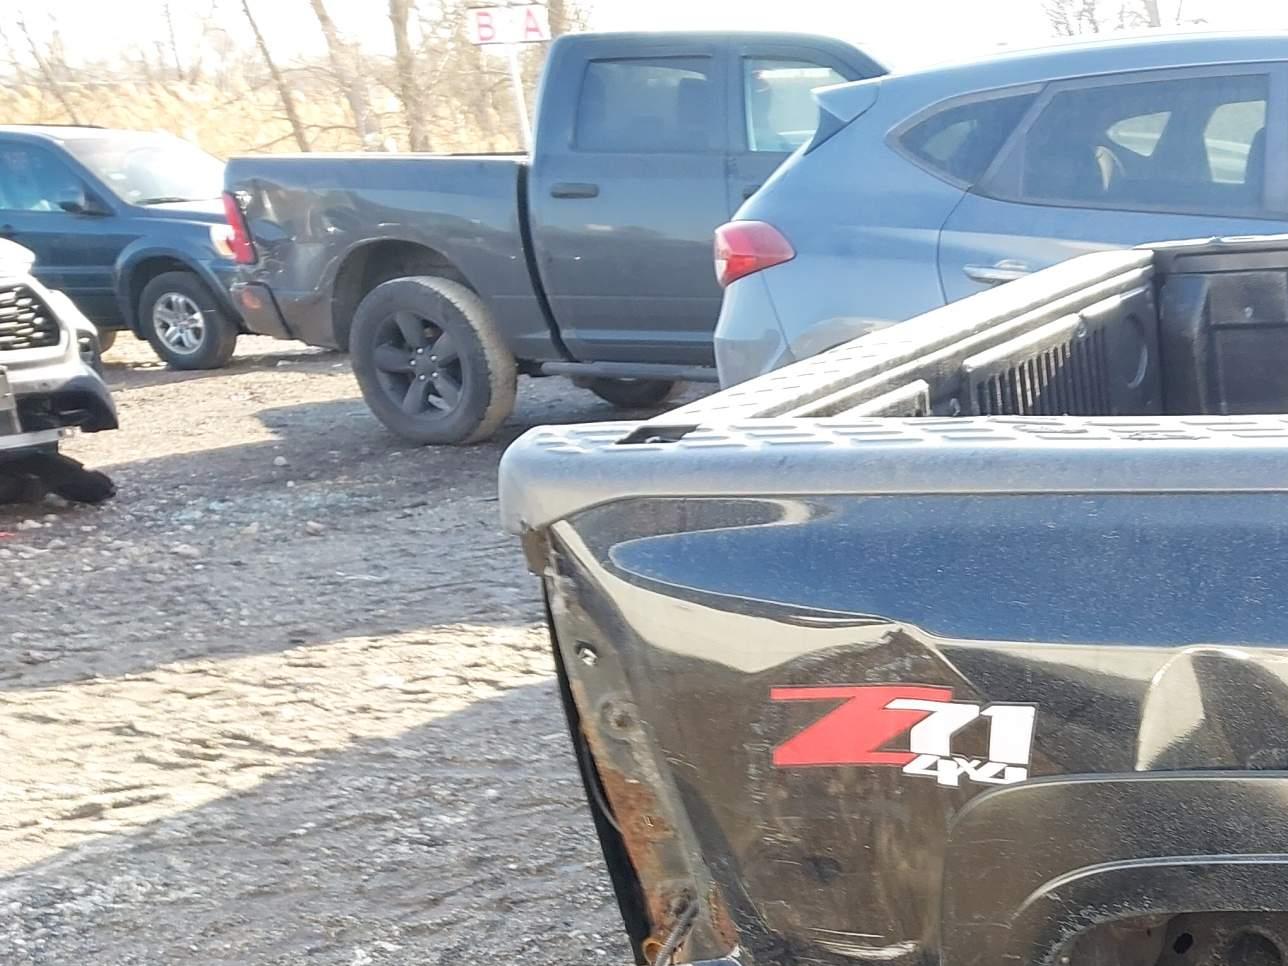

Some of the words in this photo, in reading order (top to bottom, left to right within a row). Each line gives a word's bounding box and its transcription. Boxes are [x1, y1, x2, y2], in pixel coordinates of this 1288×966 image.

[476, 11, 497, 41] B
[525, 8, 546, 40] A
[770, 686, 1037, 766] Z71
